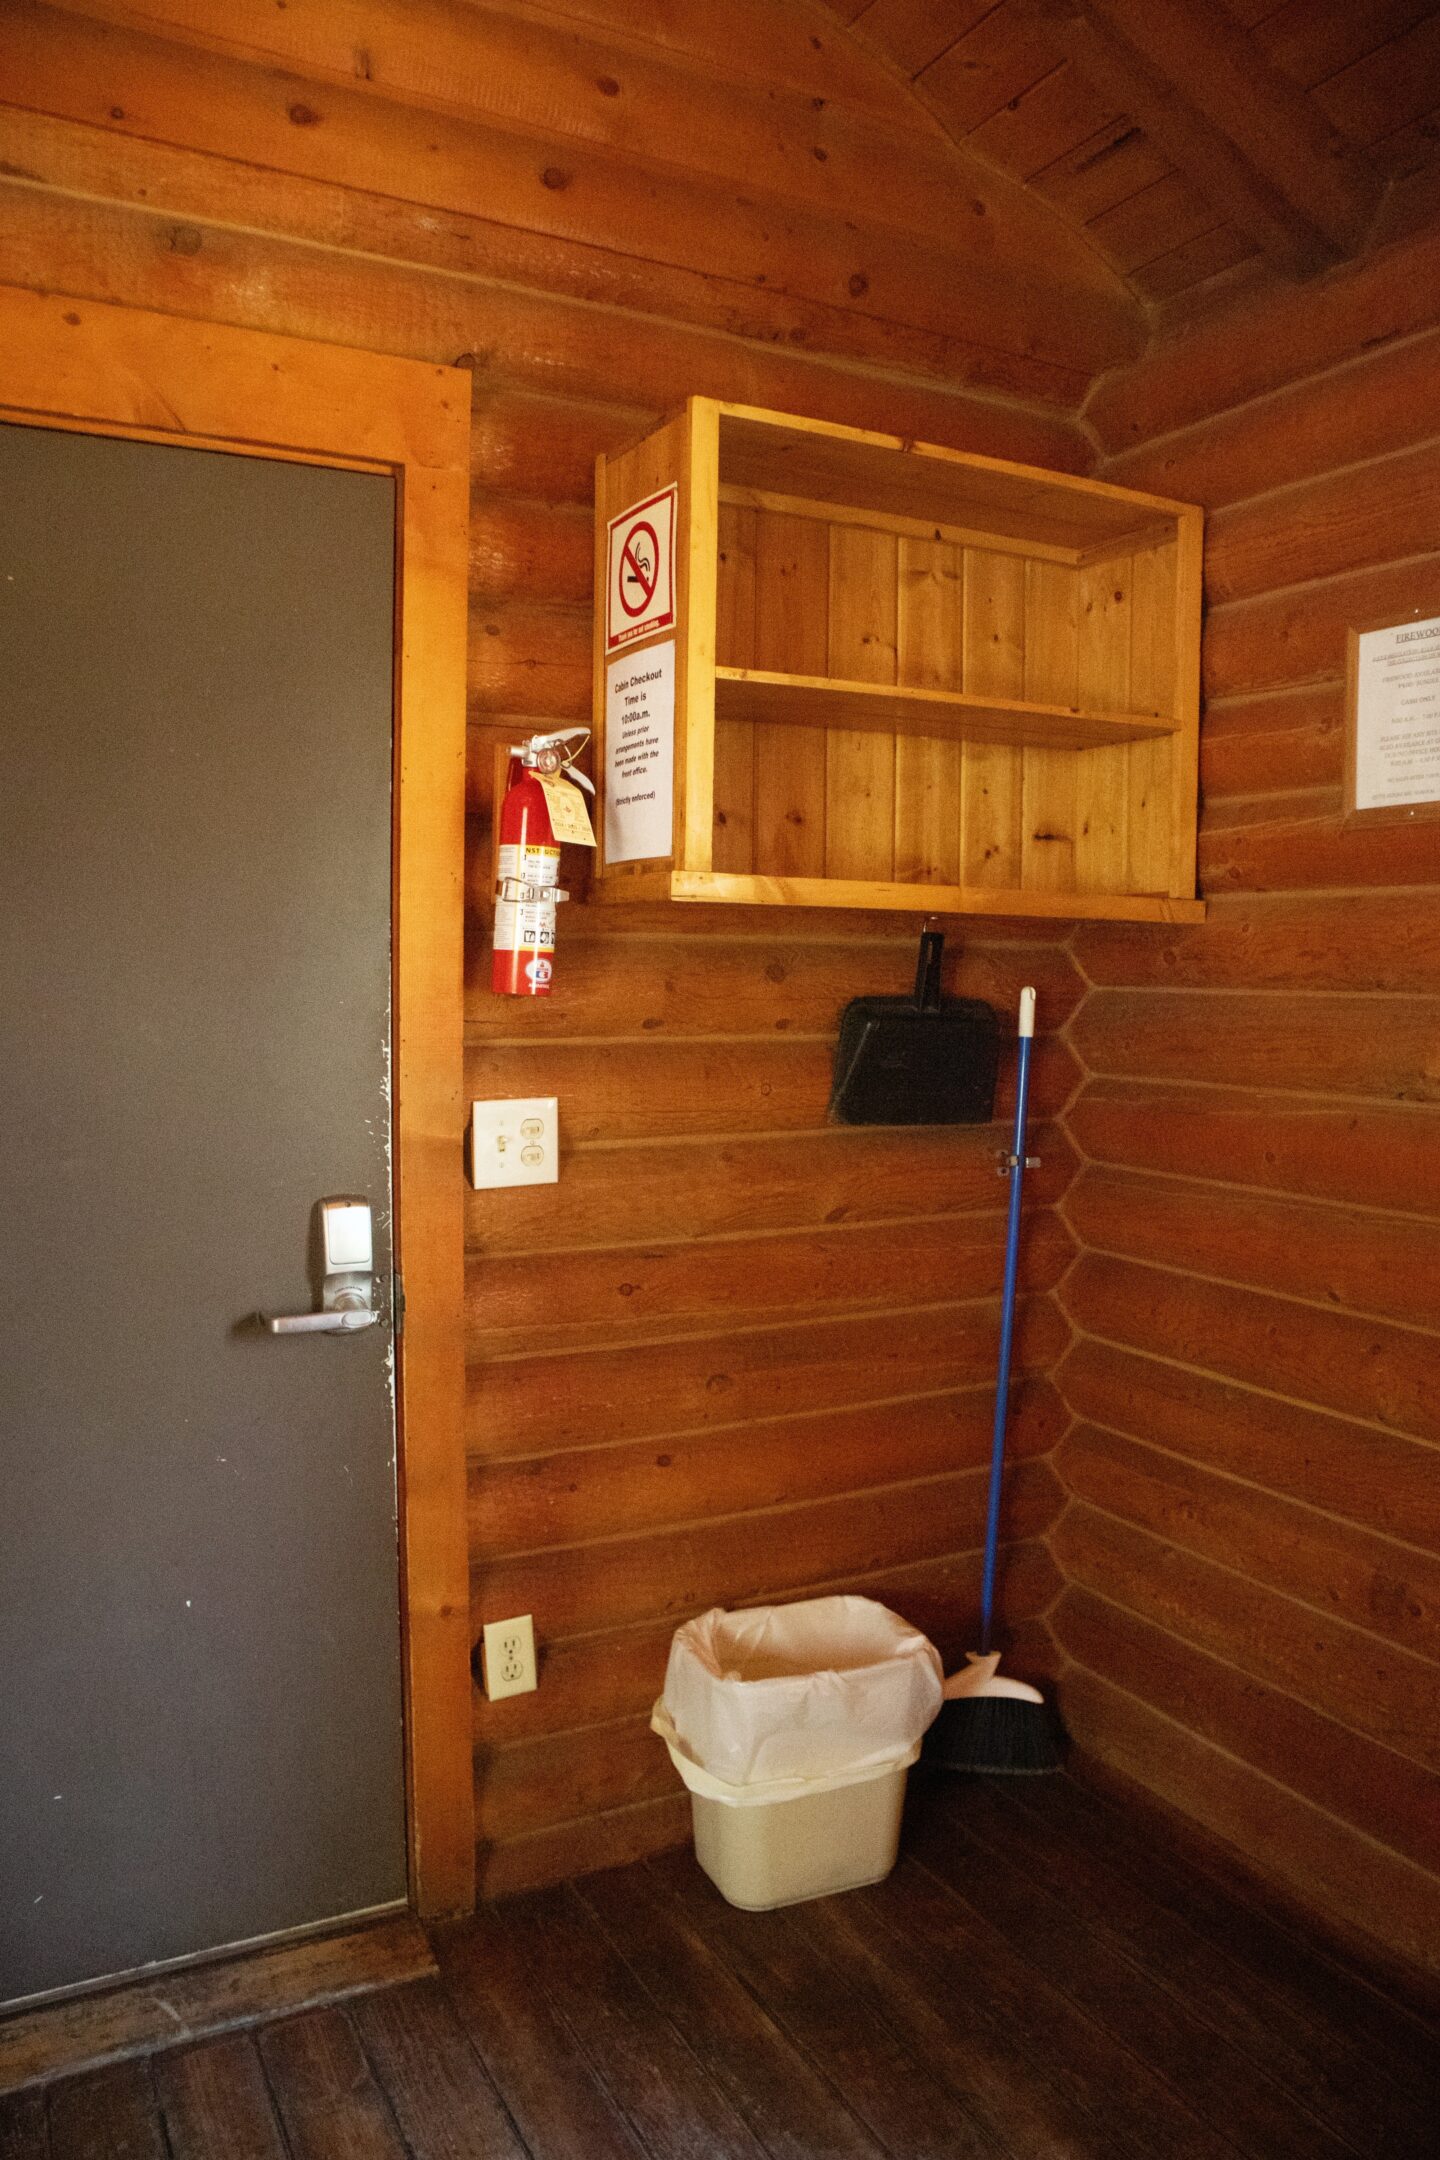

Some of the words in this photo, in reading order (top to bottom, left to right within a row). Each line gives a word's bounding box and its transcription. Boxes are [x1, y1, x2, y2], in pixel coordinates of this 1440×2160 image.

[1396, 627, 1440, 643] FIREWOO
[615, 681, 629, 693] Cabin
[630, 669, 662, 687] Checkout
[625, 695, 639, 706] Time
[641, 691, 647, 701] is
[645, 737, 659, 745] have
[624, 755, 637, 764] made
[637, 751, 649, 761] with
[650, 750, 659, 758] the
